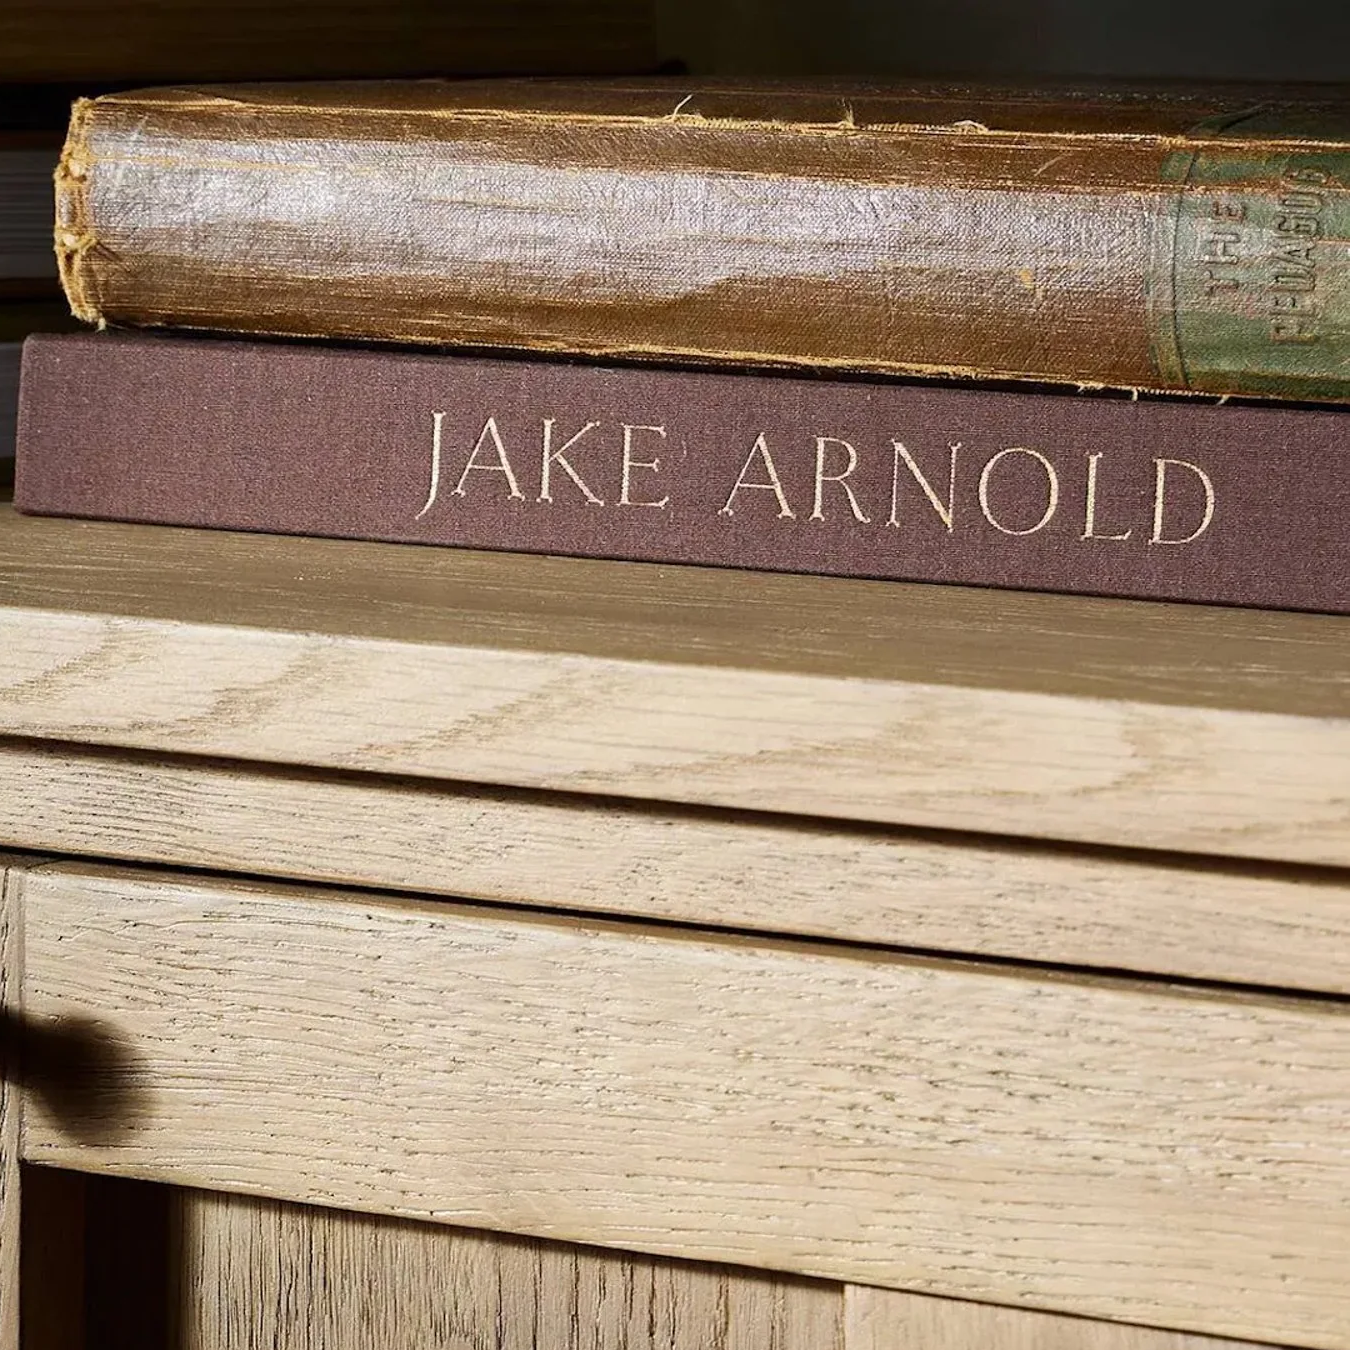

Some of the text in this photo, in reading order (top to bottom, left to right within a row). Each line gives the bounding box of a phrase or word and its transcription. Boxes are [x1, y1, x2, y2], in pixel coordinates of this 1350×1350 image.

[1204, 200, 1248, 295] THE
[414, 410, 1217, 546] JAKE ARNOLD
